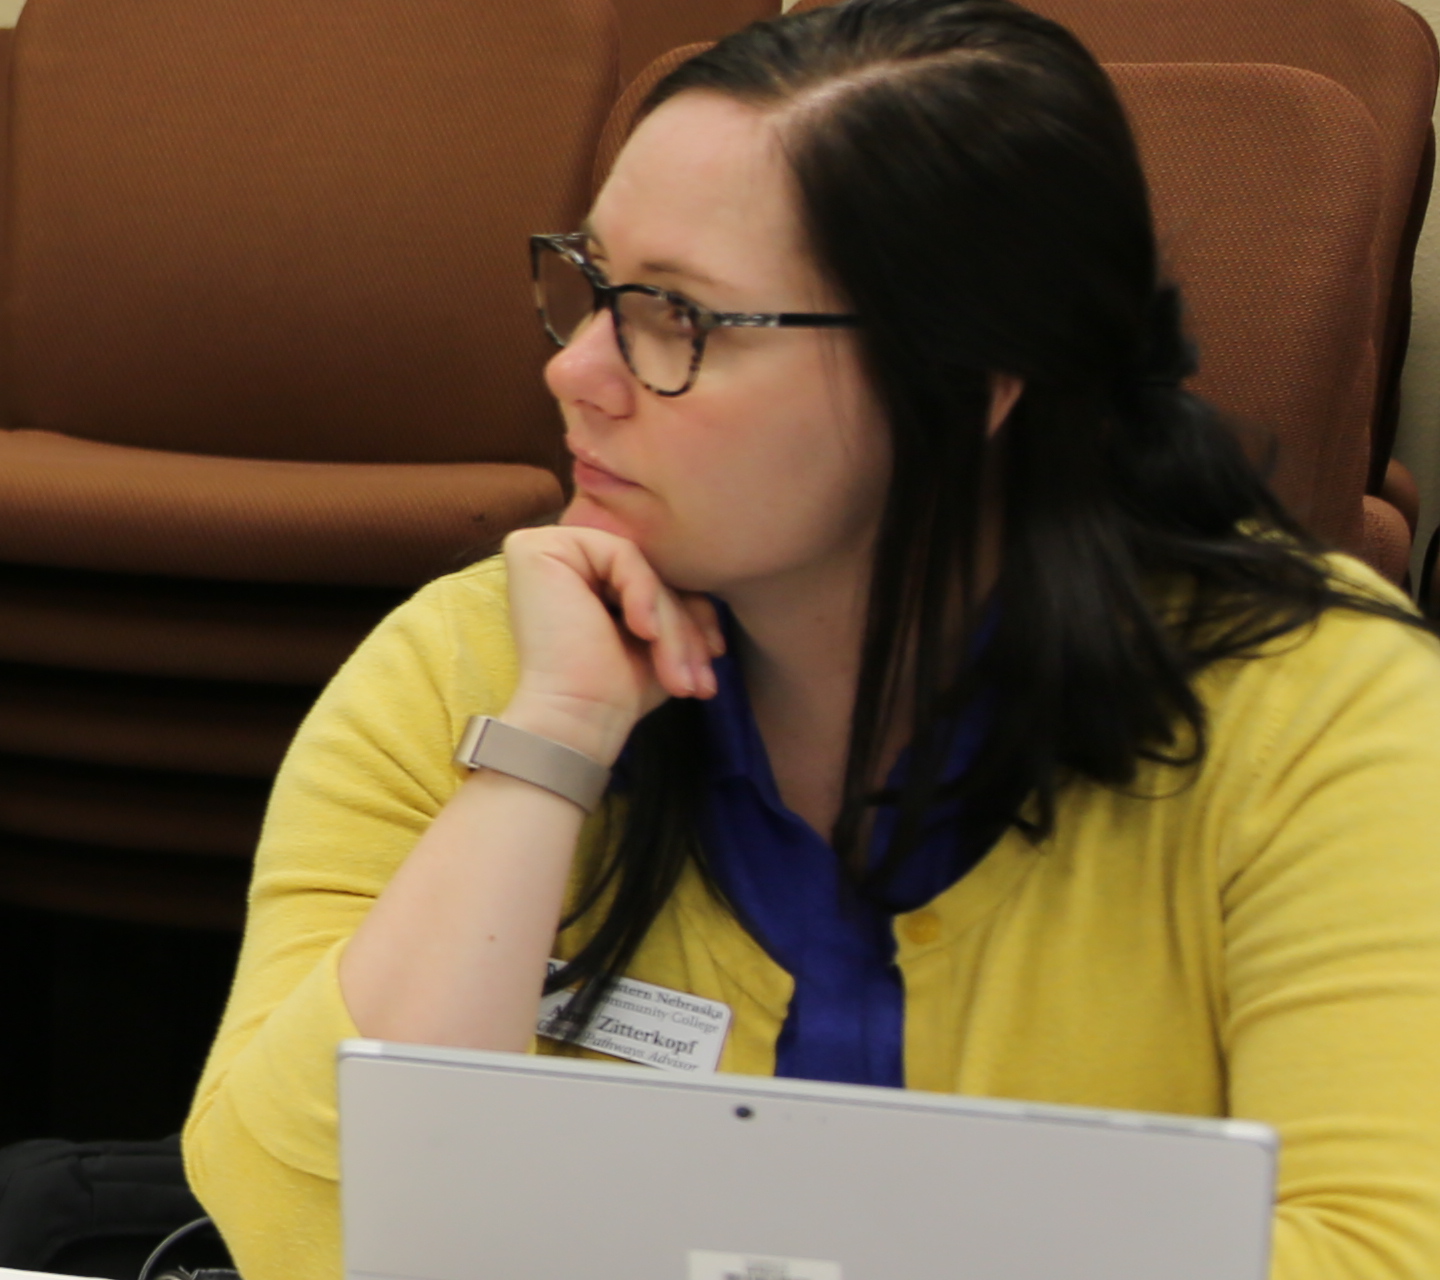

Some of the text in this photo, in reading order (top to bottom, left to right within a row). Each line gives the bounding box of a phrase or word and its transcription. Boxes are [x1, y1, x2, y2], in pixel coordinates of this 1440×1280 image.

[604, 996, 668, 1018] ommunity
[672, 1013, 719, 1034] College
[656, 993, 723, 1019] Nebraska
[598, 1015, 698, 1055] Zitterkopf
[649, 1051, 698, 1071] Advisor
